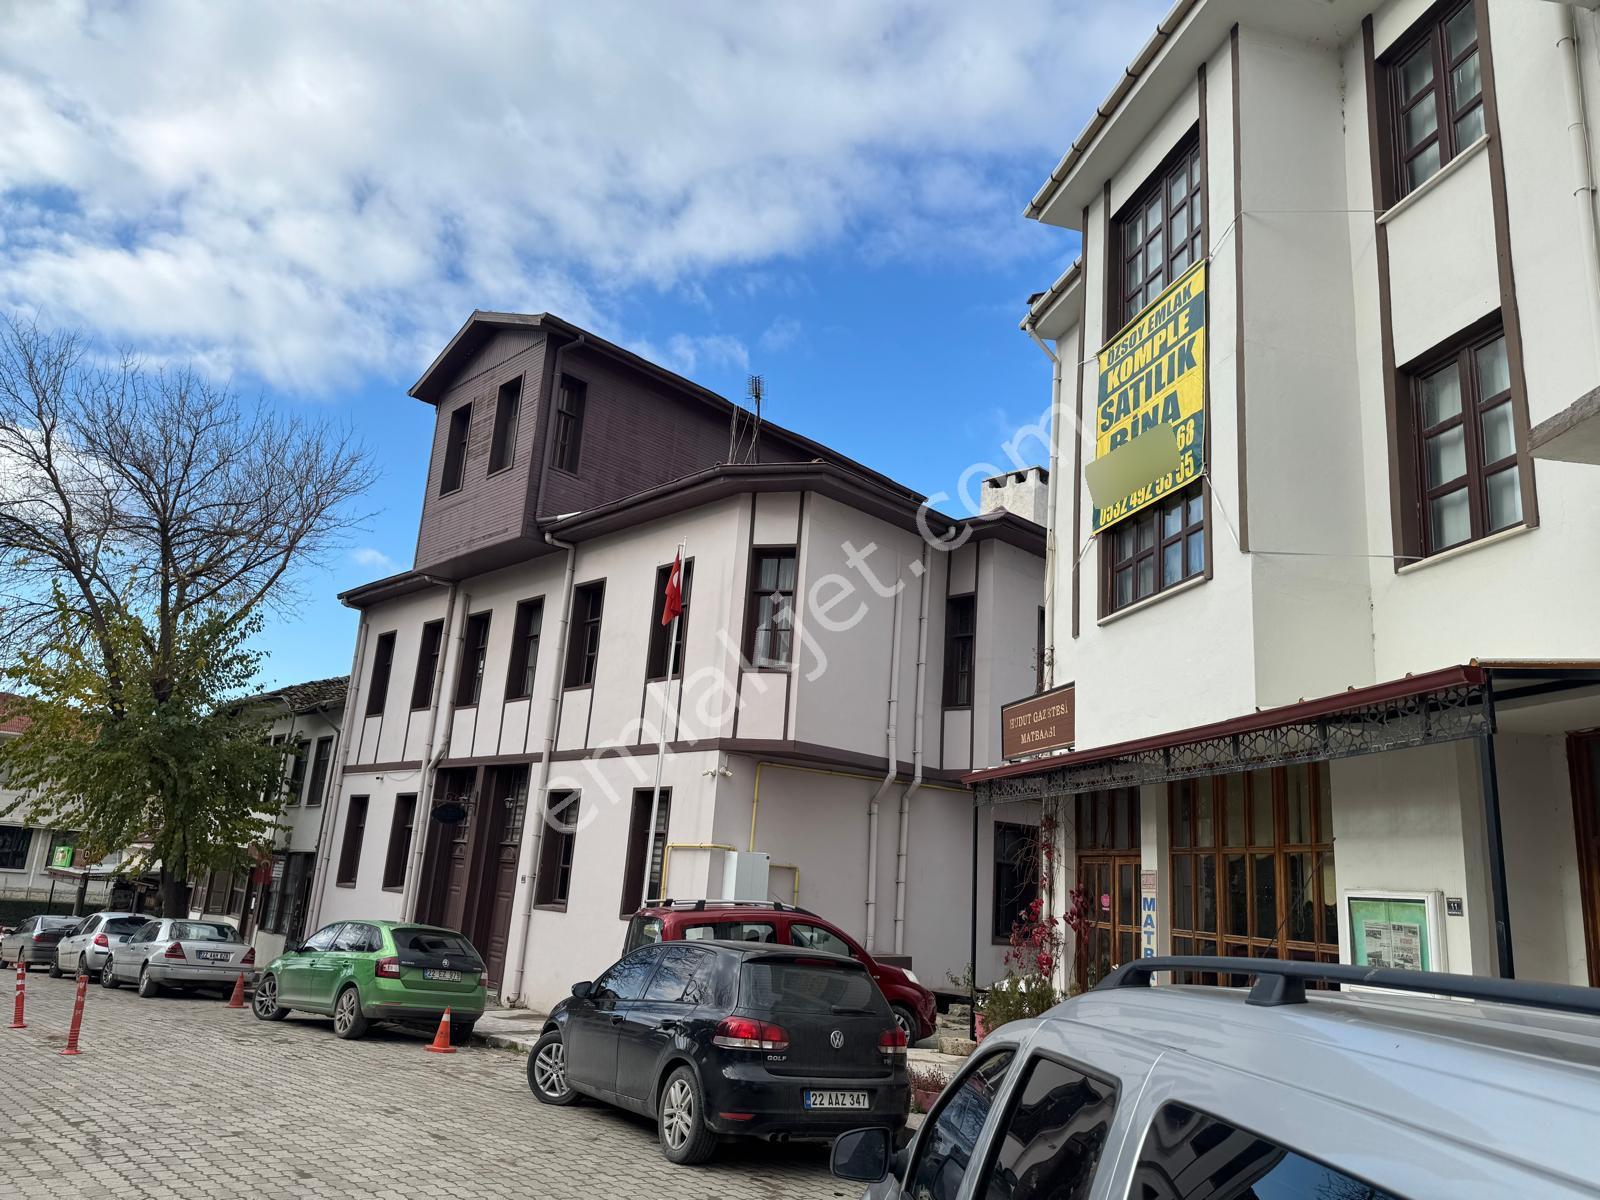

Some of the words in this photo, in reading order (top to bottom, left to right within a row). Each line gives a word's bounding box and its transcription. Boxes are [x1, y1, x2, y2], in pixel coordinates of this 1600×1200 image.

[1106, 322, 1145, 366] ÖZSOY
[1147, 280, 1192, 332] EMLAK
[1106, 307, 1190, 394] KOMPLE
[1100, 334, 1197, 433] SATILIK
[811, 1093, 825, 1106] 22
[828, 1093, 846, 1106] AAZ
[849, 1093, 866, 1106] 347
